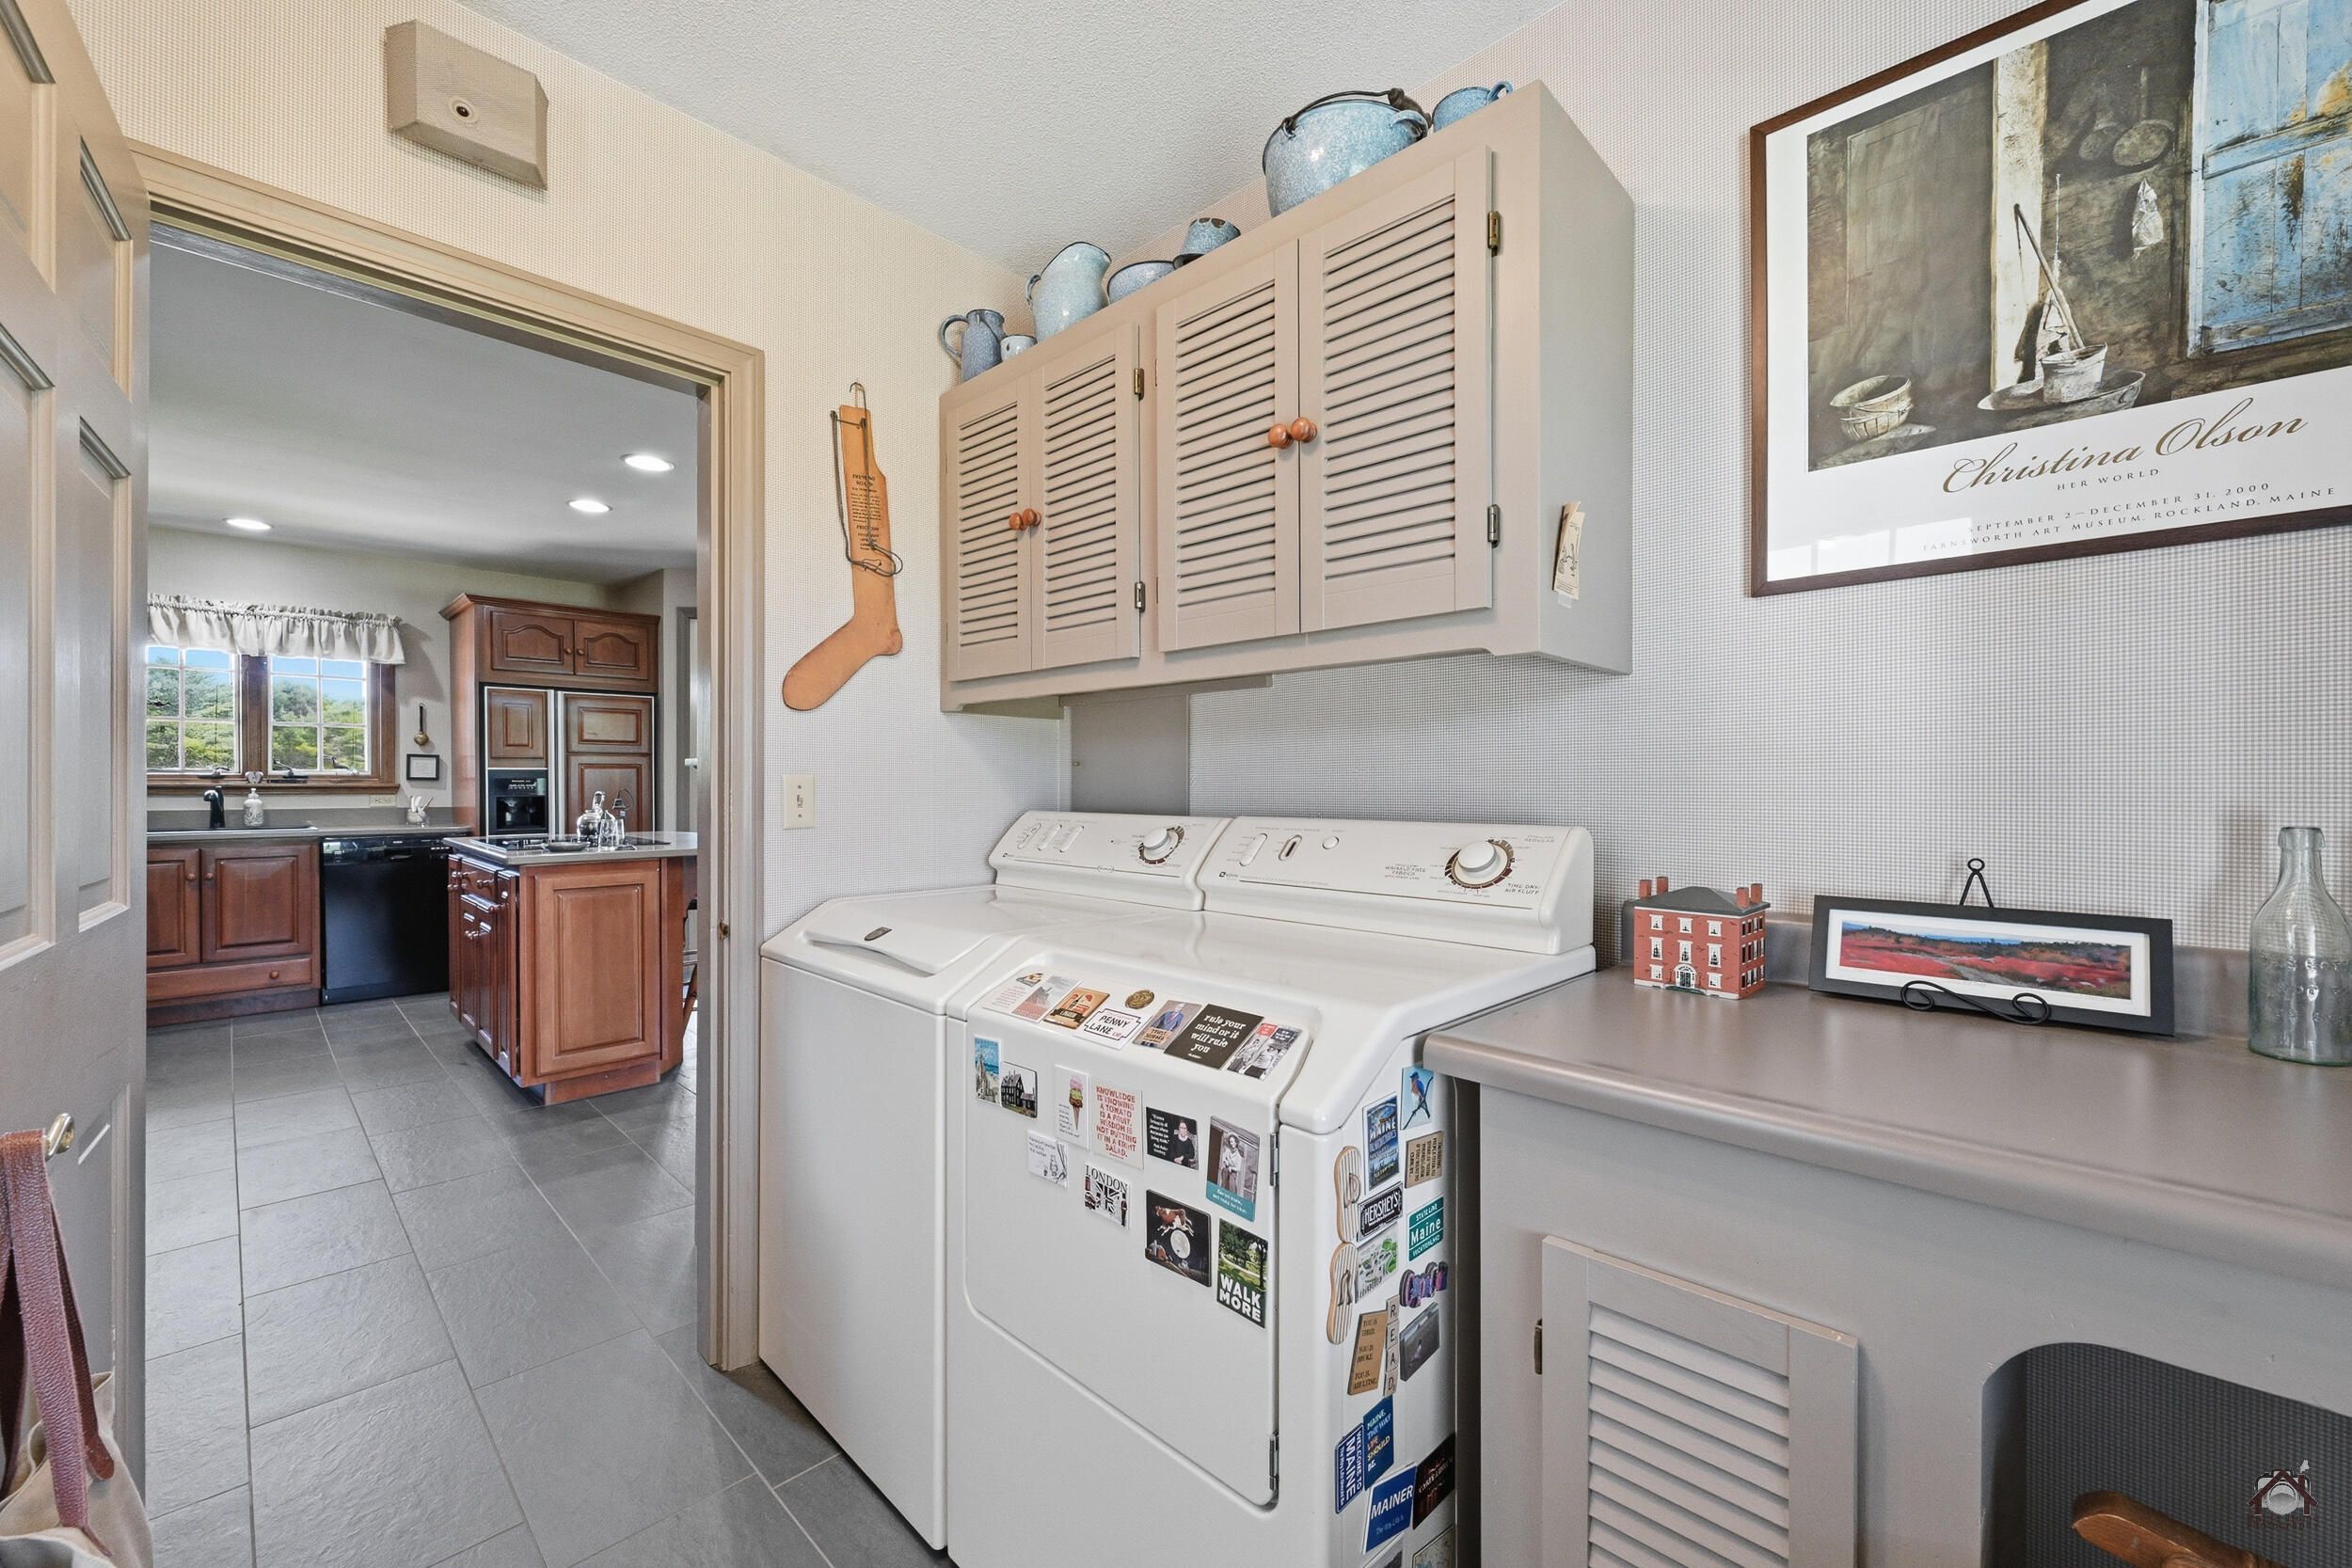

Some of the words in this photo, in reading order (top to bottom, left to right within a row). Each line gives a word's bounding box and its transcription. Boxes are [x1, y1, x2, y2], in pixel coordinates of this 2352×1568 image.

[1943, 442, 2144, 493] Christina
[2155, 397, 2308, 455] Olson
[2057, 480, 2088, 491] HER
[2098, 468, 2160, 483] WORLD
[1969, 515, 2055, 533] EPTEMBER
[2225, 483, 2269, 496] 2000
[1922, 531, 2023, 551] FARNSWORTH
[2032, 526, 2061, 536] ART
[2269, 487, 2335, 503] MAINE
[1089, 1022, 1114, 1035] LANE
[1099, 1015, 1130, 1028] PENNY
[1195, 1023, 1221, 1034] mind
[1230, 1030, 1240, 1039] it
[1203, 1015, 1224, 1024] rule
[1221, 1020, 1247, 1030] your
[1190, 1043, 1211, 1053] you
[1191, 1033, 1210, 1043] will
[1207, 1037, 1229, 1048] rule
[1096, 1085, 1136, 1103] KNOWLEDGE
[1100, 1110, 1105, 1118] IS
[1106, 1104, 1132, 1117] TOMATO
[1096, 1124, 1108, 1134] NOT
[1110, 1129, 1137, 1144] PUTTING
[1100, 1117, 1125, 1132] WISDOM
[1104, 1134, 1111, 1144] IN
[1118, 1139, 1136, 1152] FRUIT
[1086, 1164, 1128, 1195] LONDON
[1364, 1191, 1399, 1225] HERSHEY'S
[1416, 1209, 1428, 1222] STATE
[1428, 1203, 1438, 1213] LINE
[1411, 1218, 1441, 1246] Maine
[1220, 1273, 1262, 1309] WALK
[1219, 1288, 1262, 1323] MORE
[1367, 1425, 1379, 1440] THE
[1378, 1413, 1391, 1430] WAY
[1367, 1435, 1391, 1462] SHOULD
[1345, 1435, 1356, 1501] MAINE
[1356, 1476, 1362, 1491] TO
[1370, 1484, 1414, 1520] MAINER
